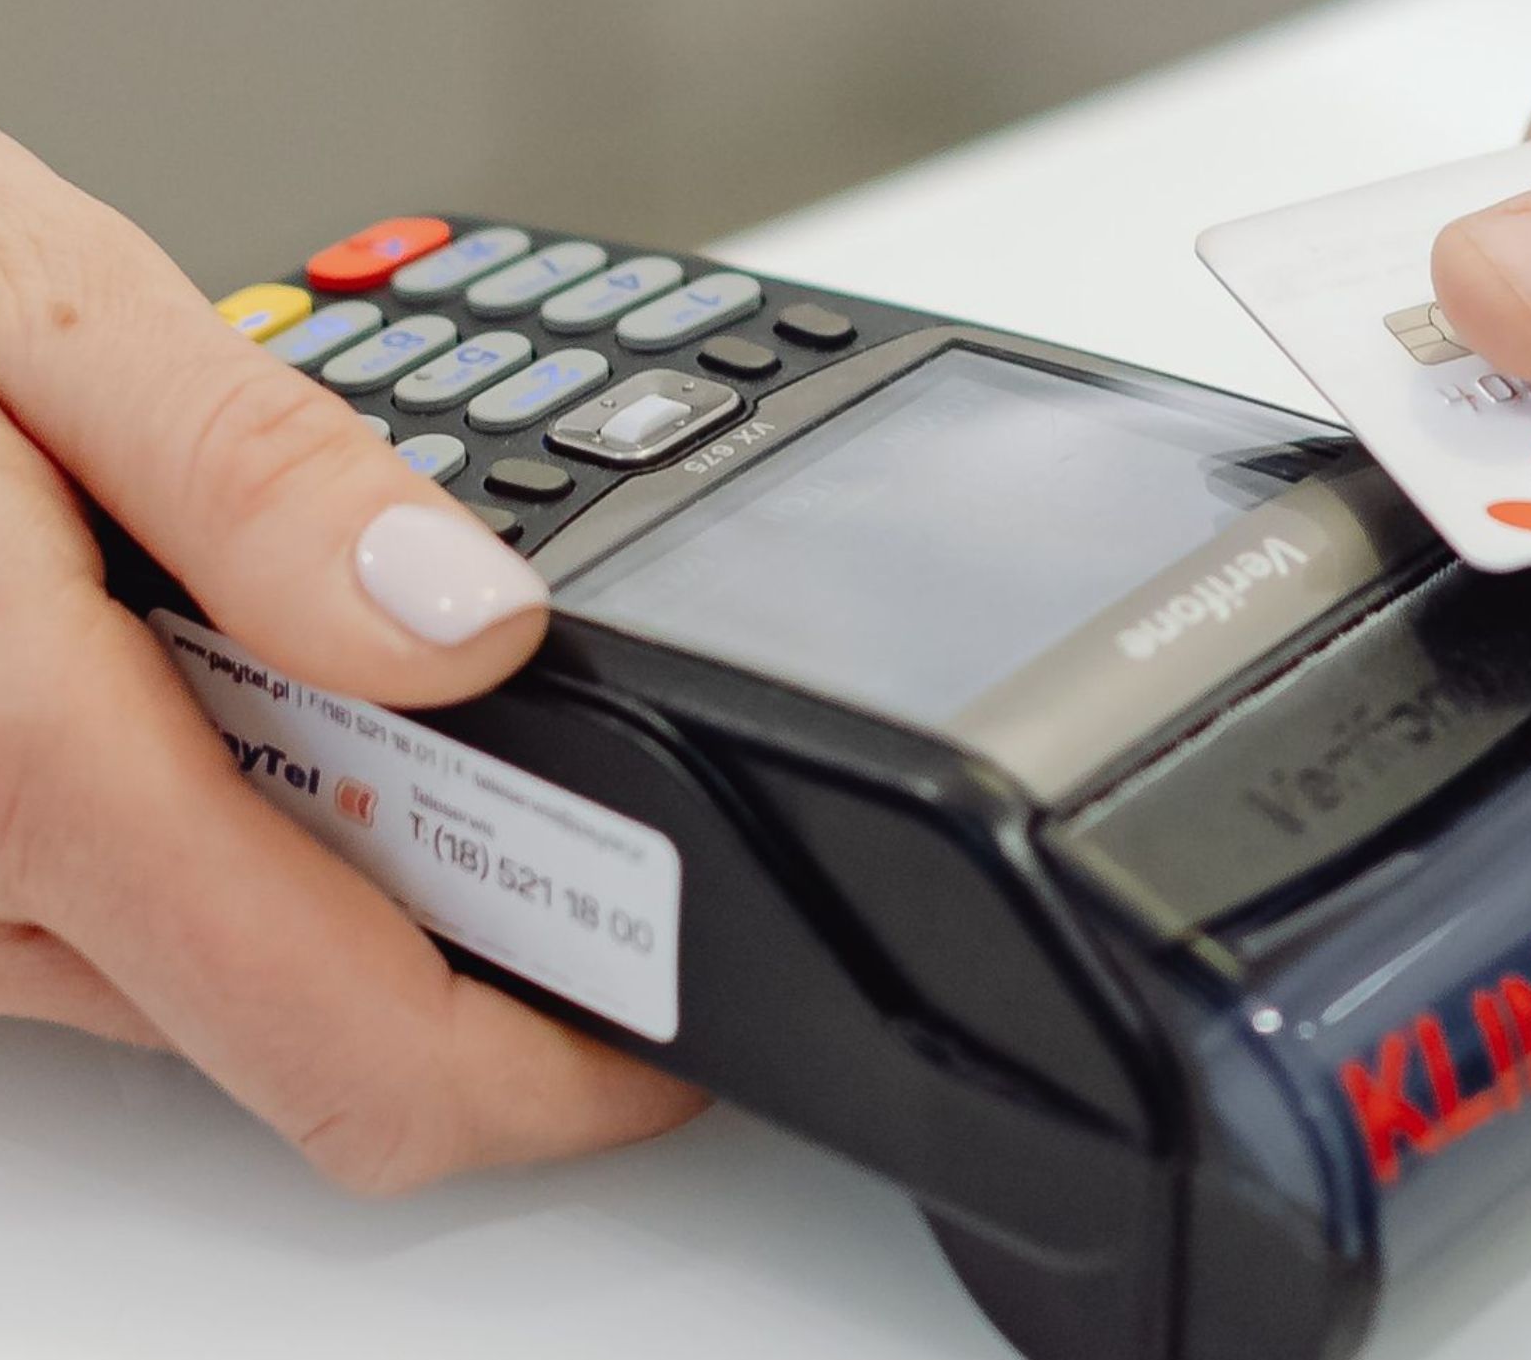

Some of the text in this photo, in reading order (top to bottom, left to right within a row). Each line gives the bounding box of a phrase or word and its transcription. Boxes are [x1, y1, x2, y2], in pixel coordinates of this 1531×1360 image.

[455, 346, 502, 366] 5
[683, 421, 776, 475] VX 675
[1117, 537, 1310, 660] Verifone
[222, 731, 321, 795] ayTel
[433, 823, 490, 882] (18)
[497, 855, 552, 908] 521
[565, 886, 600, 931] 18
[609, 905, 656, 955] 00
